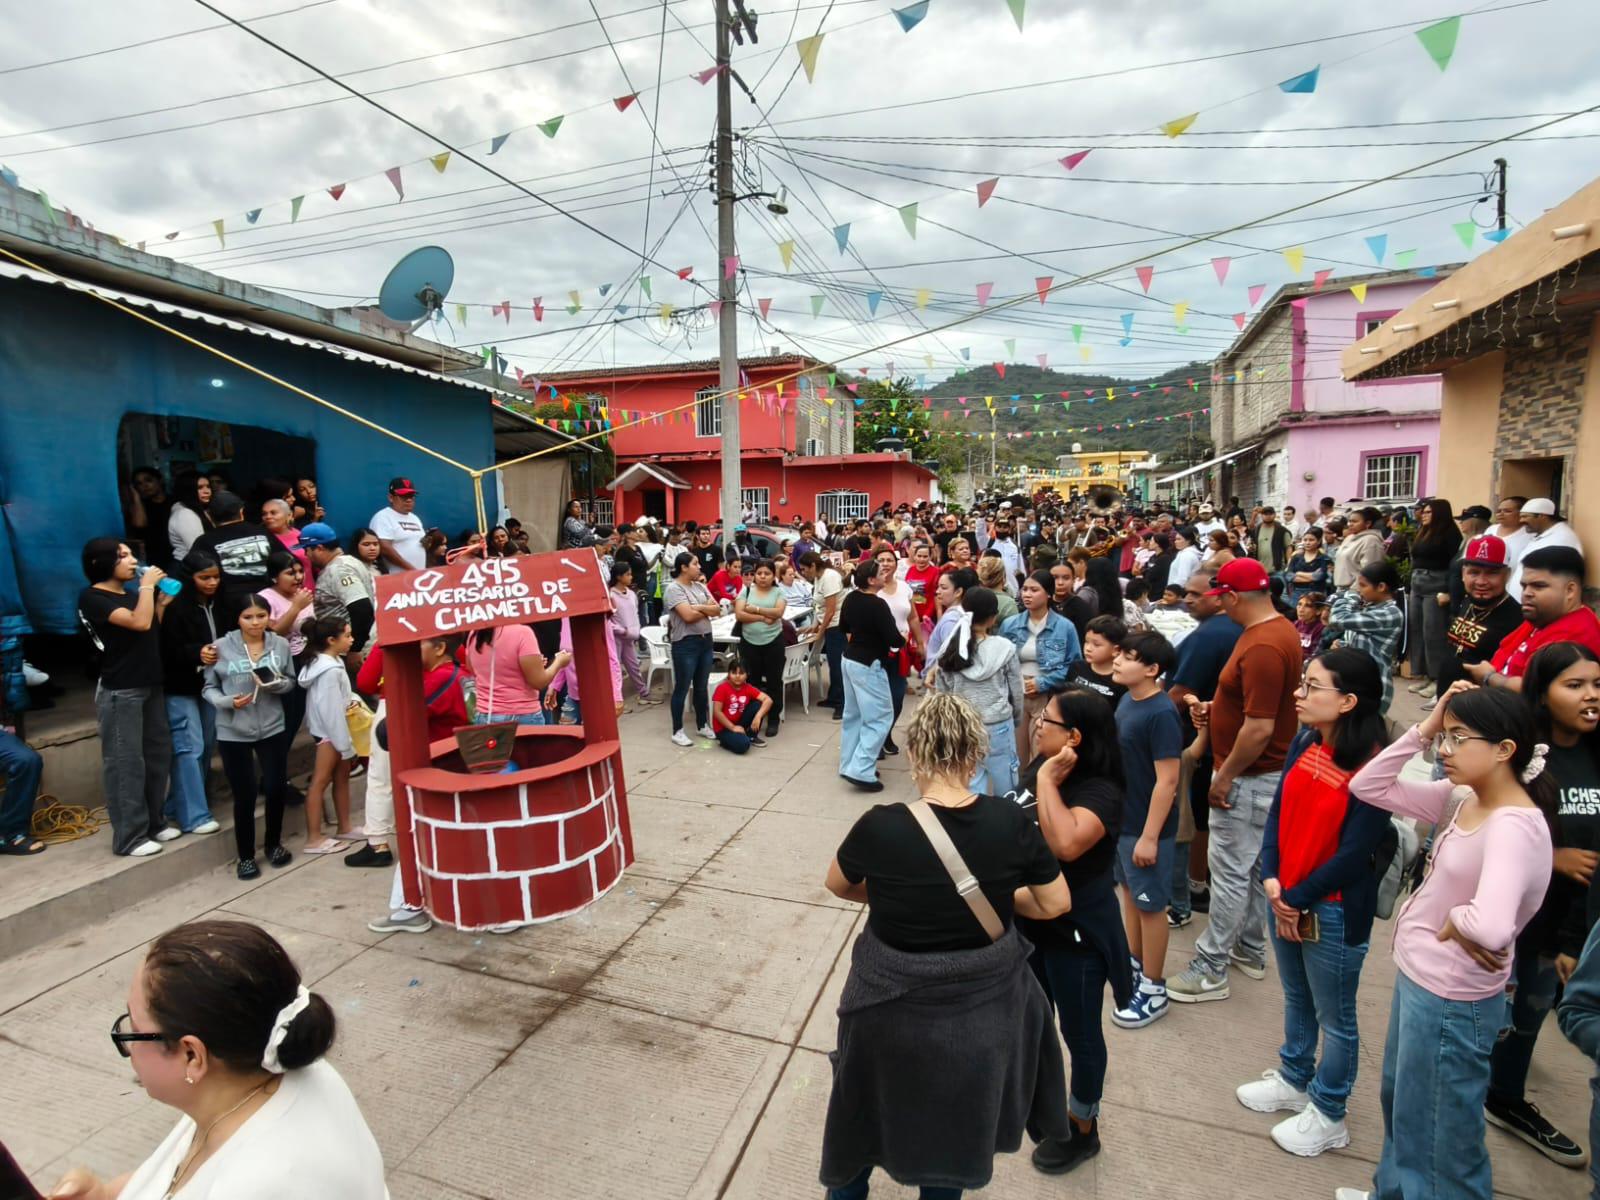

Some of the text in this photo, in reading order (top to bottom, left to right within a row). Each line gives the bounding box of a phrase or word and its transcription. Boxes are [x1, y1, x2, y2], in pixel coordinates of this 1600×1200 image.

[462, 558, 521, 588] 495
[384, 578, 572, 611] ANIVERSARIO DE
[435, 595, 567, 631] CHAMETLA
[1568, 787, 1600, 803] CHE
